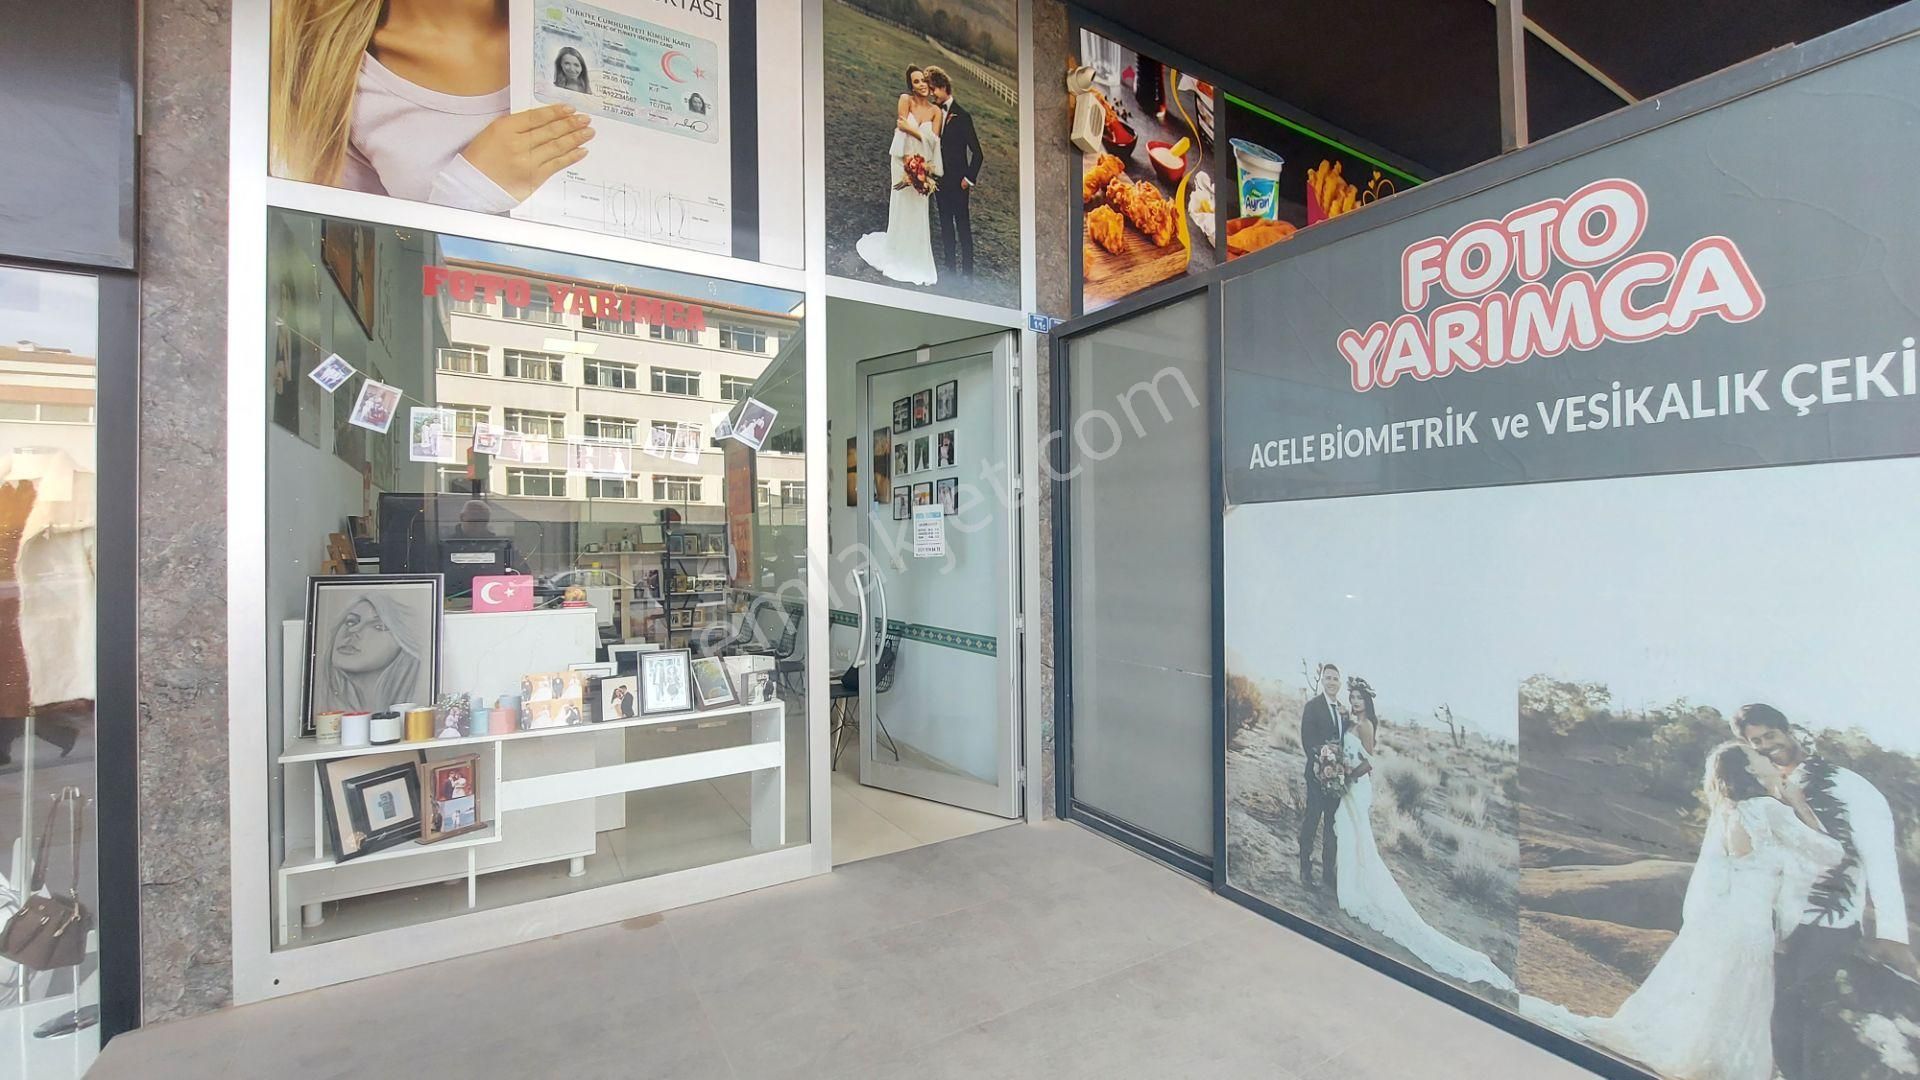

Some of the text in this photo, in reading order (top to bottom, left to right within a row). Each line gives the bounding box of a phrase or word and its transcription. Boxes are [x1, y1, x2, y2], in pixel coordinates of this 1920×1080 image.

[638, 35, 658, 45] IDENTITY
[660, 41, 672, 49] CARD
[1245, 196, 1270, 211] Ayran
[1402, 178, 1648, 312] FOTO
[422, 265, 706, 332] FOTO YARIMCA
[1338, 235, 1765, 392] YARIMCA
[1249, 336, 1919, 472] ACELE BİOMETRİK ve VESİKALIK ÇEKİ
